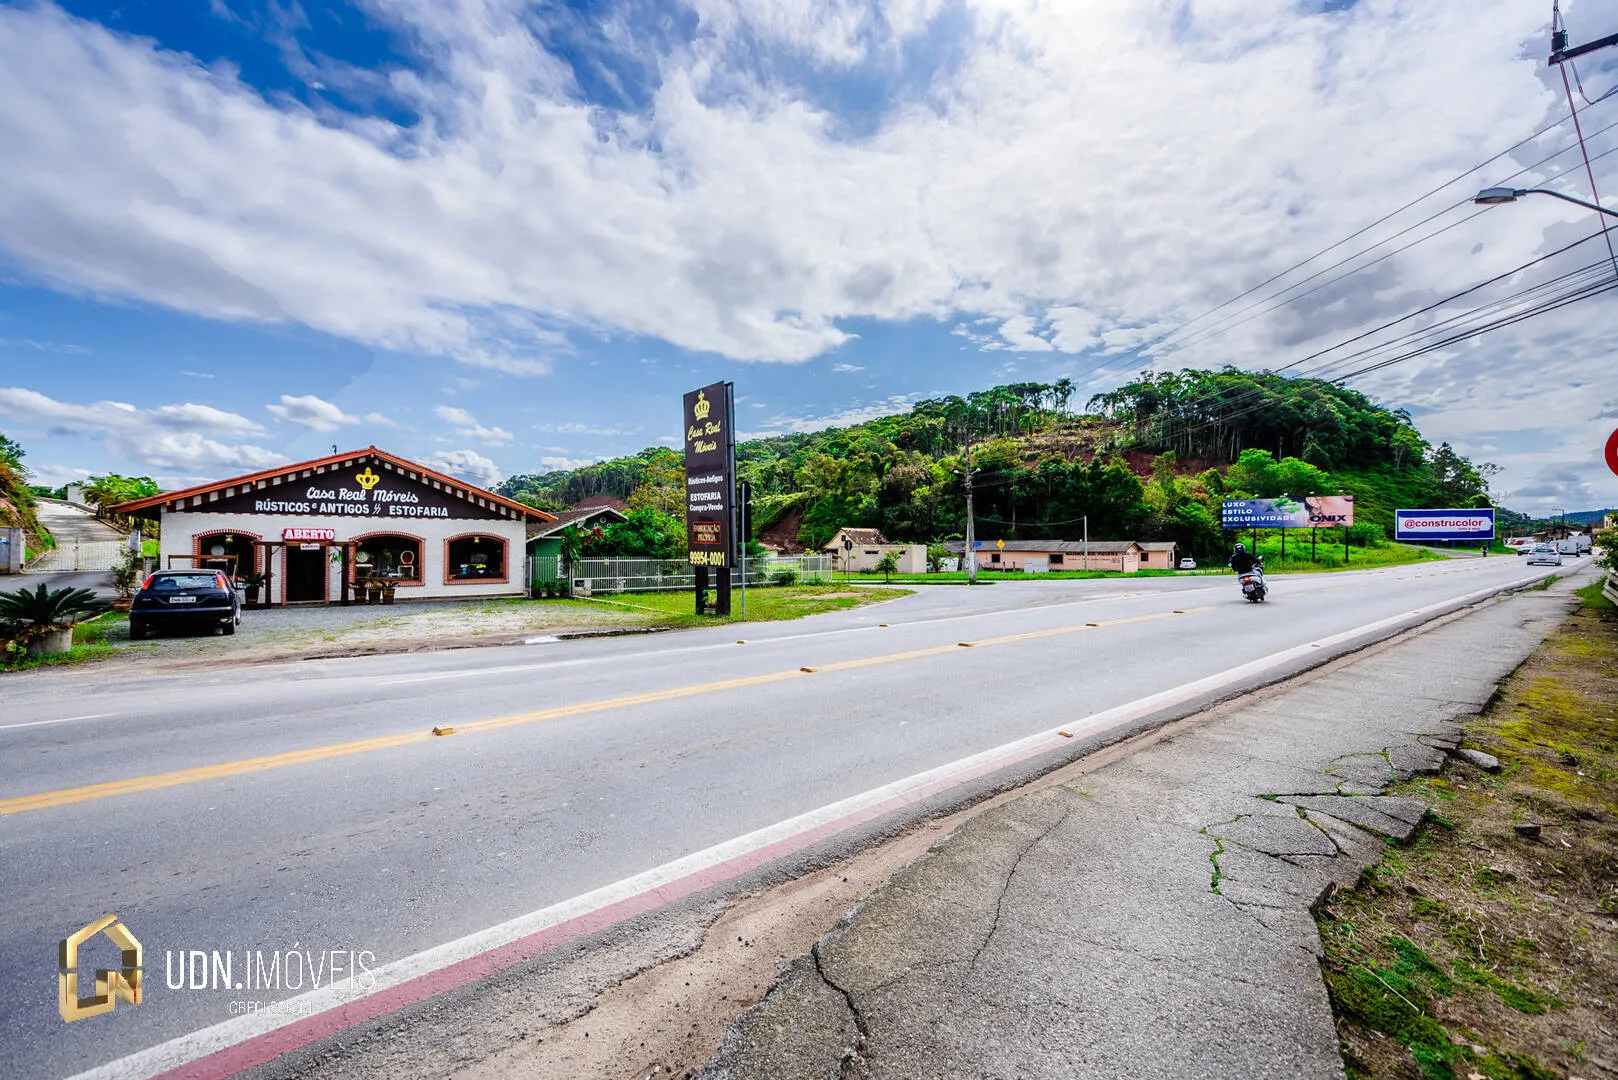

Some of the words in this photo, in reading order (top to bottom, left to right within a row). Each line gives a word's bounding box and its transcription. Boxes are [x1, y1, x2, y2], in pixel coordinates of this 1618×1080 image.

[687, 425, 703, 441] Casa
[705, 420, 721, 436] Real
[693, 440, 717, 454] Móveis
[306, 487, 336, 500] Casa
[339, 488, 366, 501] Real
[373, 490, 419, 503] Móveis
[690, 491, 722, 502] ESTOFARIA
[255, 499, 310, 512] RÚSTICOS
[319, 502, 370, 514] ANTIGOS
[389, 505, 449, 517] ESTOFARIA
[1309, 514, 1347, 523] ONIX
[1404, 518, 1484, 530] @construcolor
[284, 529, 334, 539] ABERTO
[690, 551, 725, 566] 99954-0001
